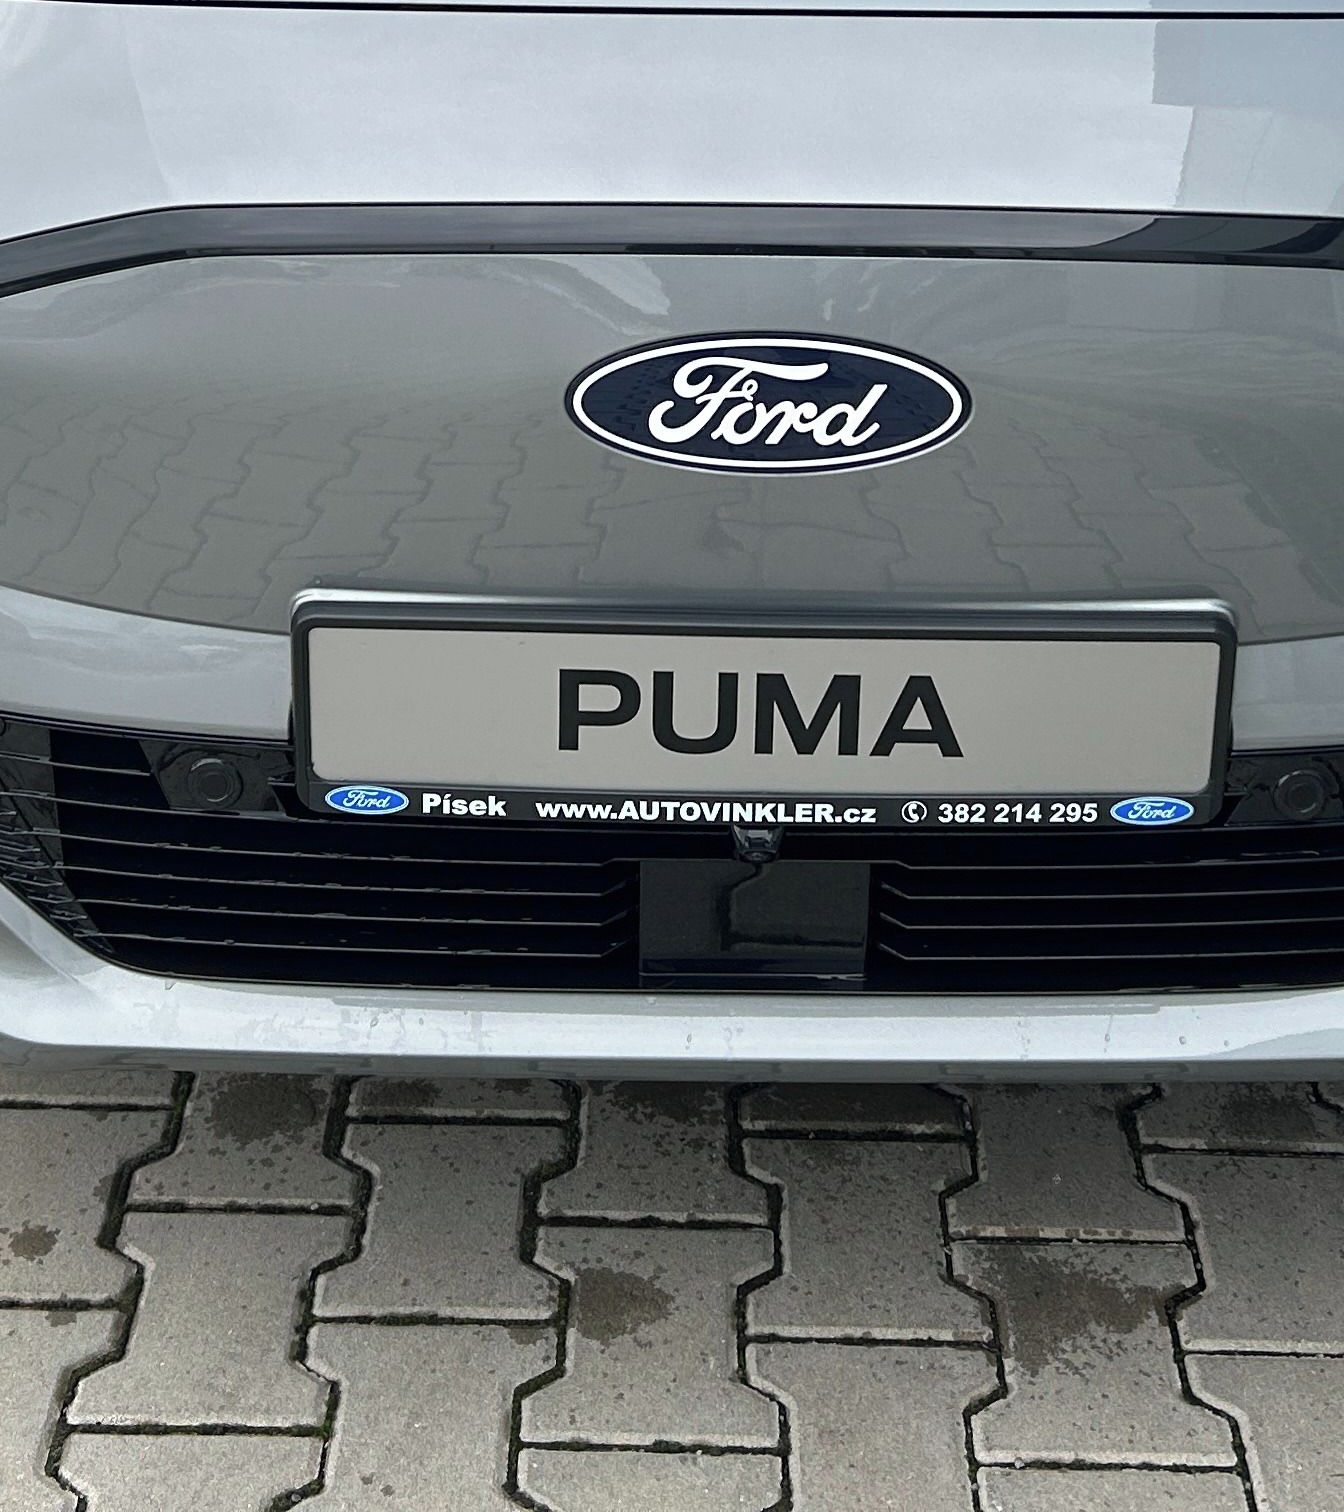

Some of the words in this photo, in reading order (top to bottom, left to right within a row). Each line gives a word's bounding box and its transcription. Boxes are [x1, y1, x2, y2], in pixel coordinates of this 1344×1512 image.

[648, 356, 888, 447] Ford
[558, 668, 964, 758] PUMA
[342, 789, 391, 808] Ford
[422, 792, 507, 817] Písek
[535, 799, 877, 823] www.AUTOVINKLER.cz
[937, 803, 986, 823] 382
[993, 803, 1042, 823] 214
[1049, 802, 1098, 823] 295
[1127, 801, 1177, 819] Ford
